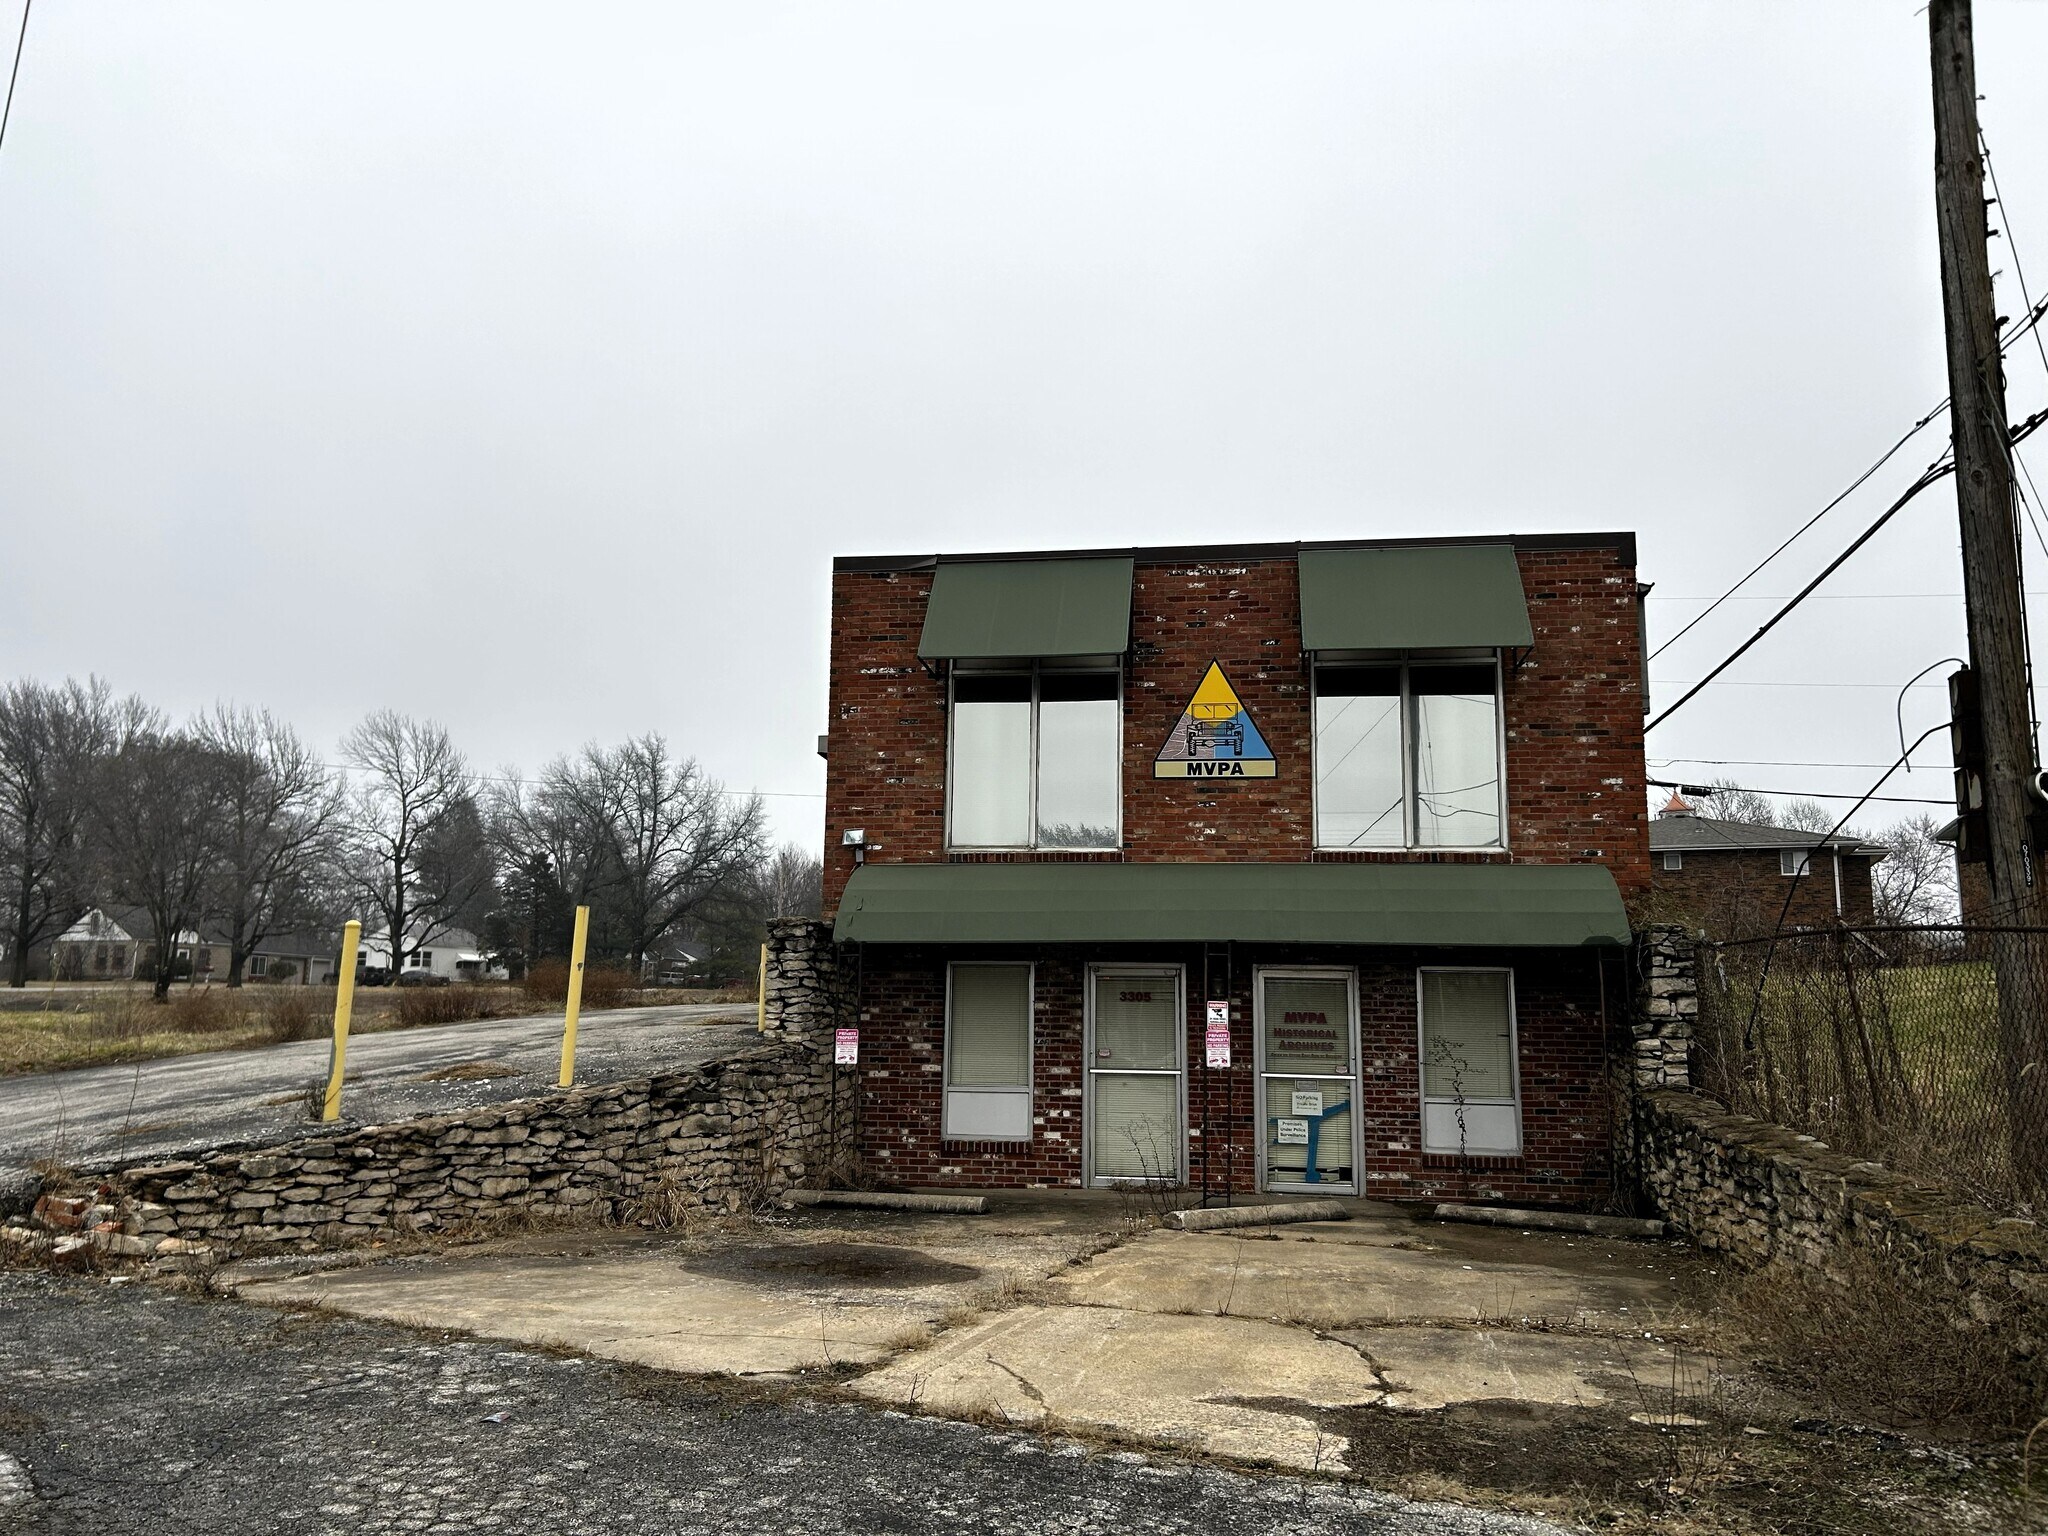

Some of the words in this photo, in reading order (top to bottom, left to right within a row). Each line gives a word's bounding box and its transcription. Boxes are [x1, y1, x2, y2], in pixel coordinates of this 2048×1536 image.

[1187, 762, 1244, 776] MVPA
[1120, 991, 1152, 1002] 3305
[1284, 1011, 1328, 1024] MVPA
